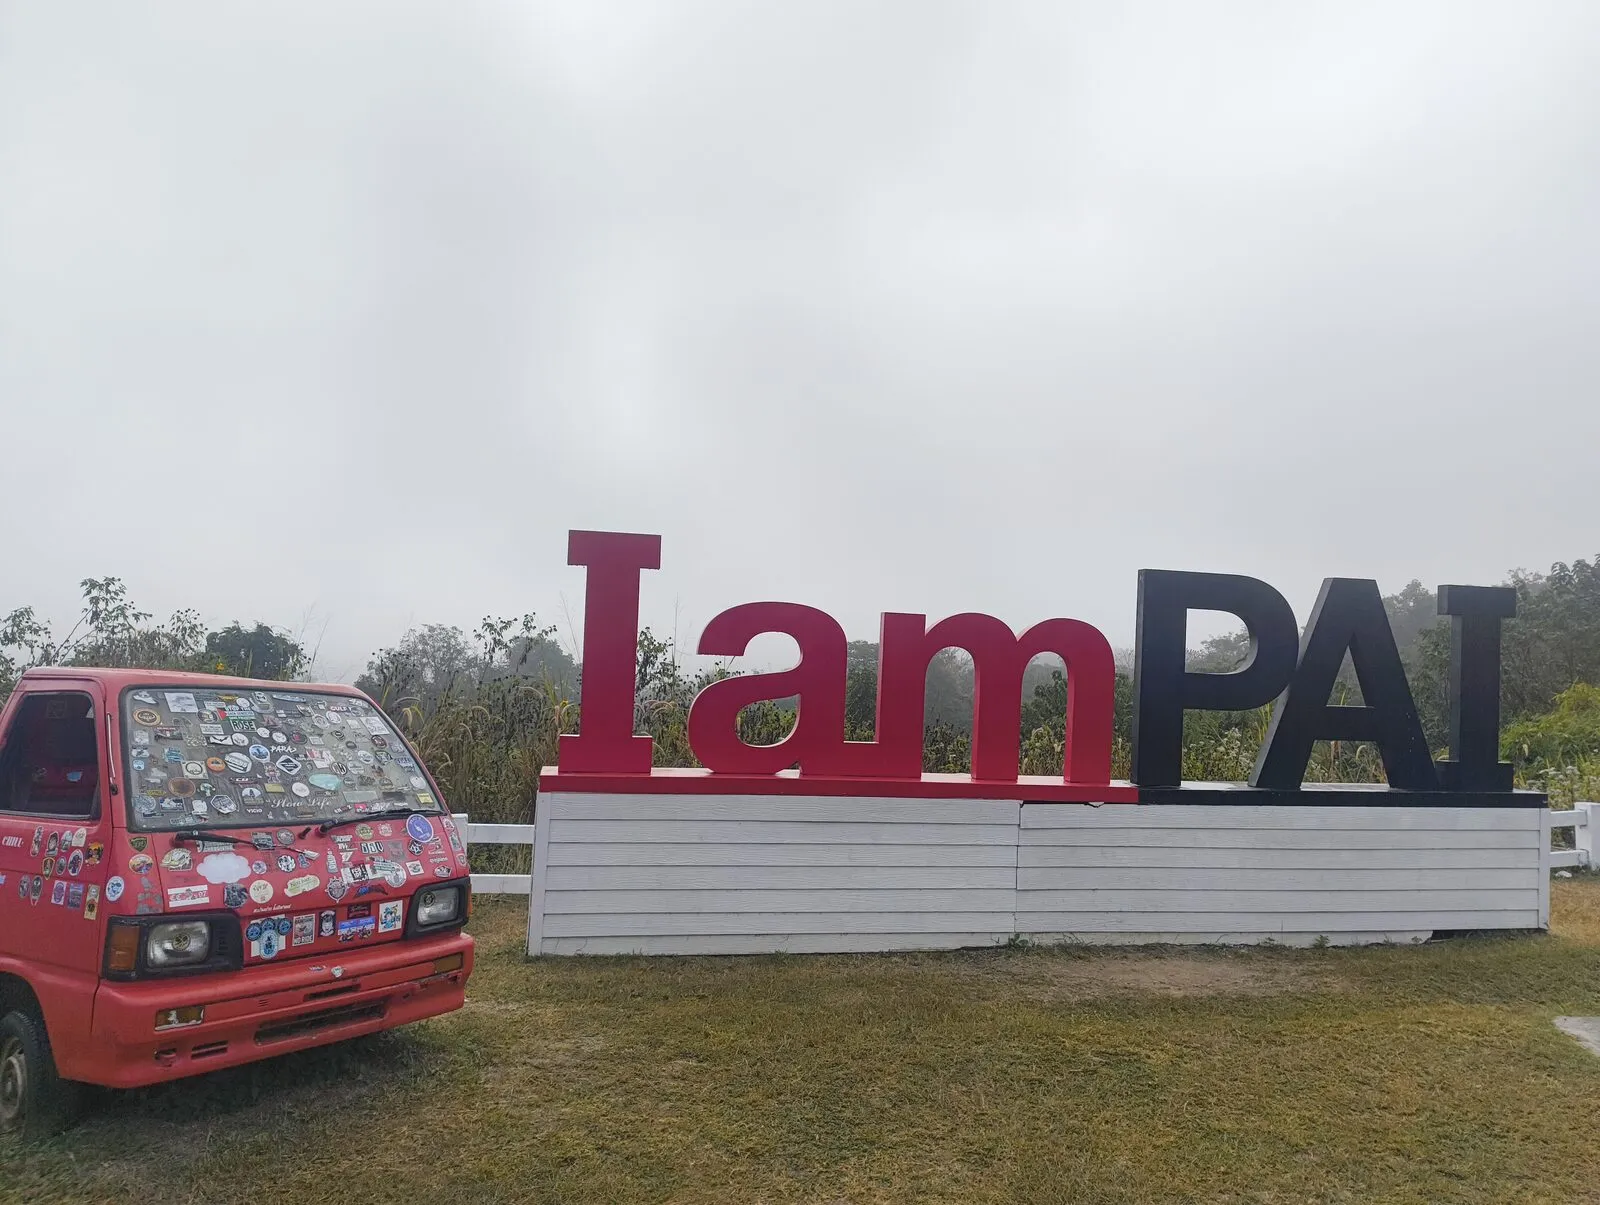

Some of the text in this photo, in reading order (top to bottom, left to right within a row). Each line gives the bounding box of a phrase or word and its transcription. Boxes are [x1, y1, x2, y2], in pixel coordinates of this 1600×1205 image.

[232, 720, 255, 730] ROSE
[557, 529, 662, 774] I
[1130, 568, 1517, 793] PAI
